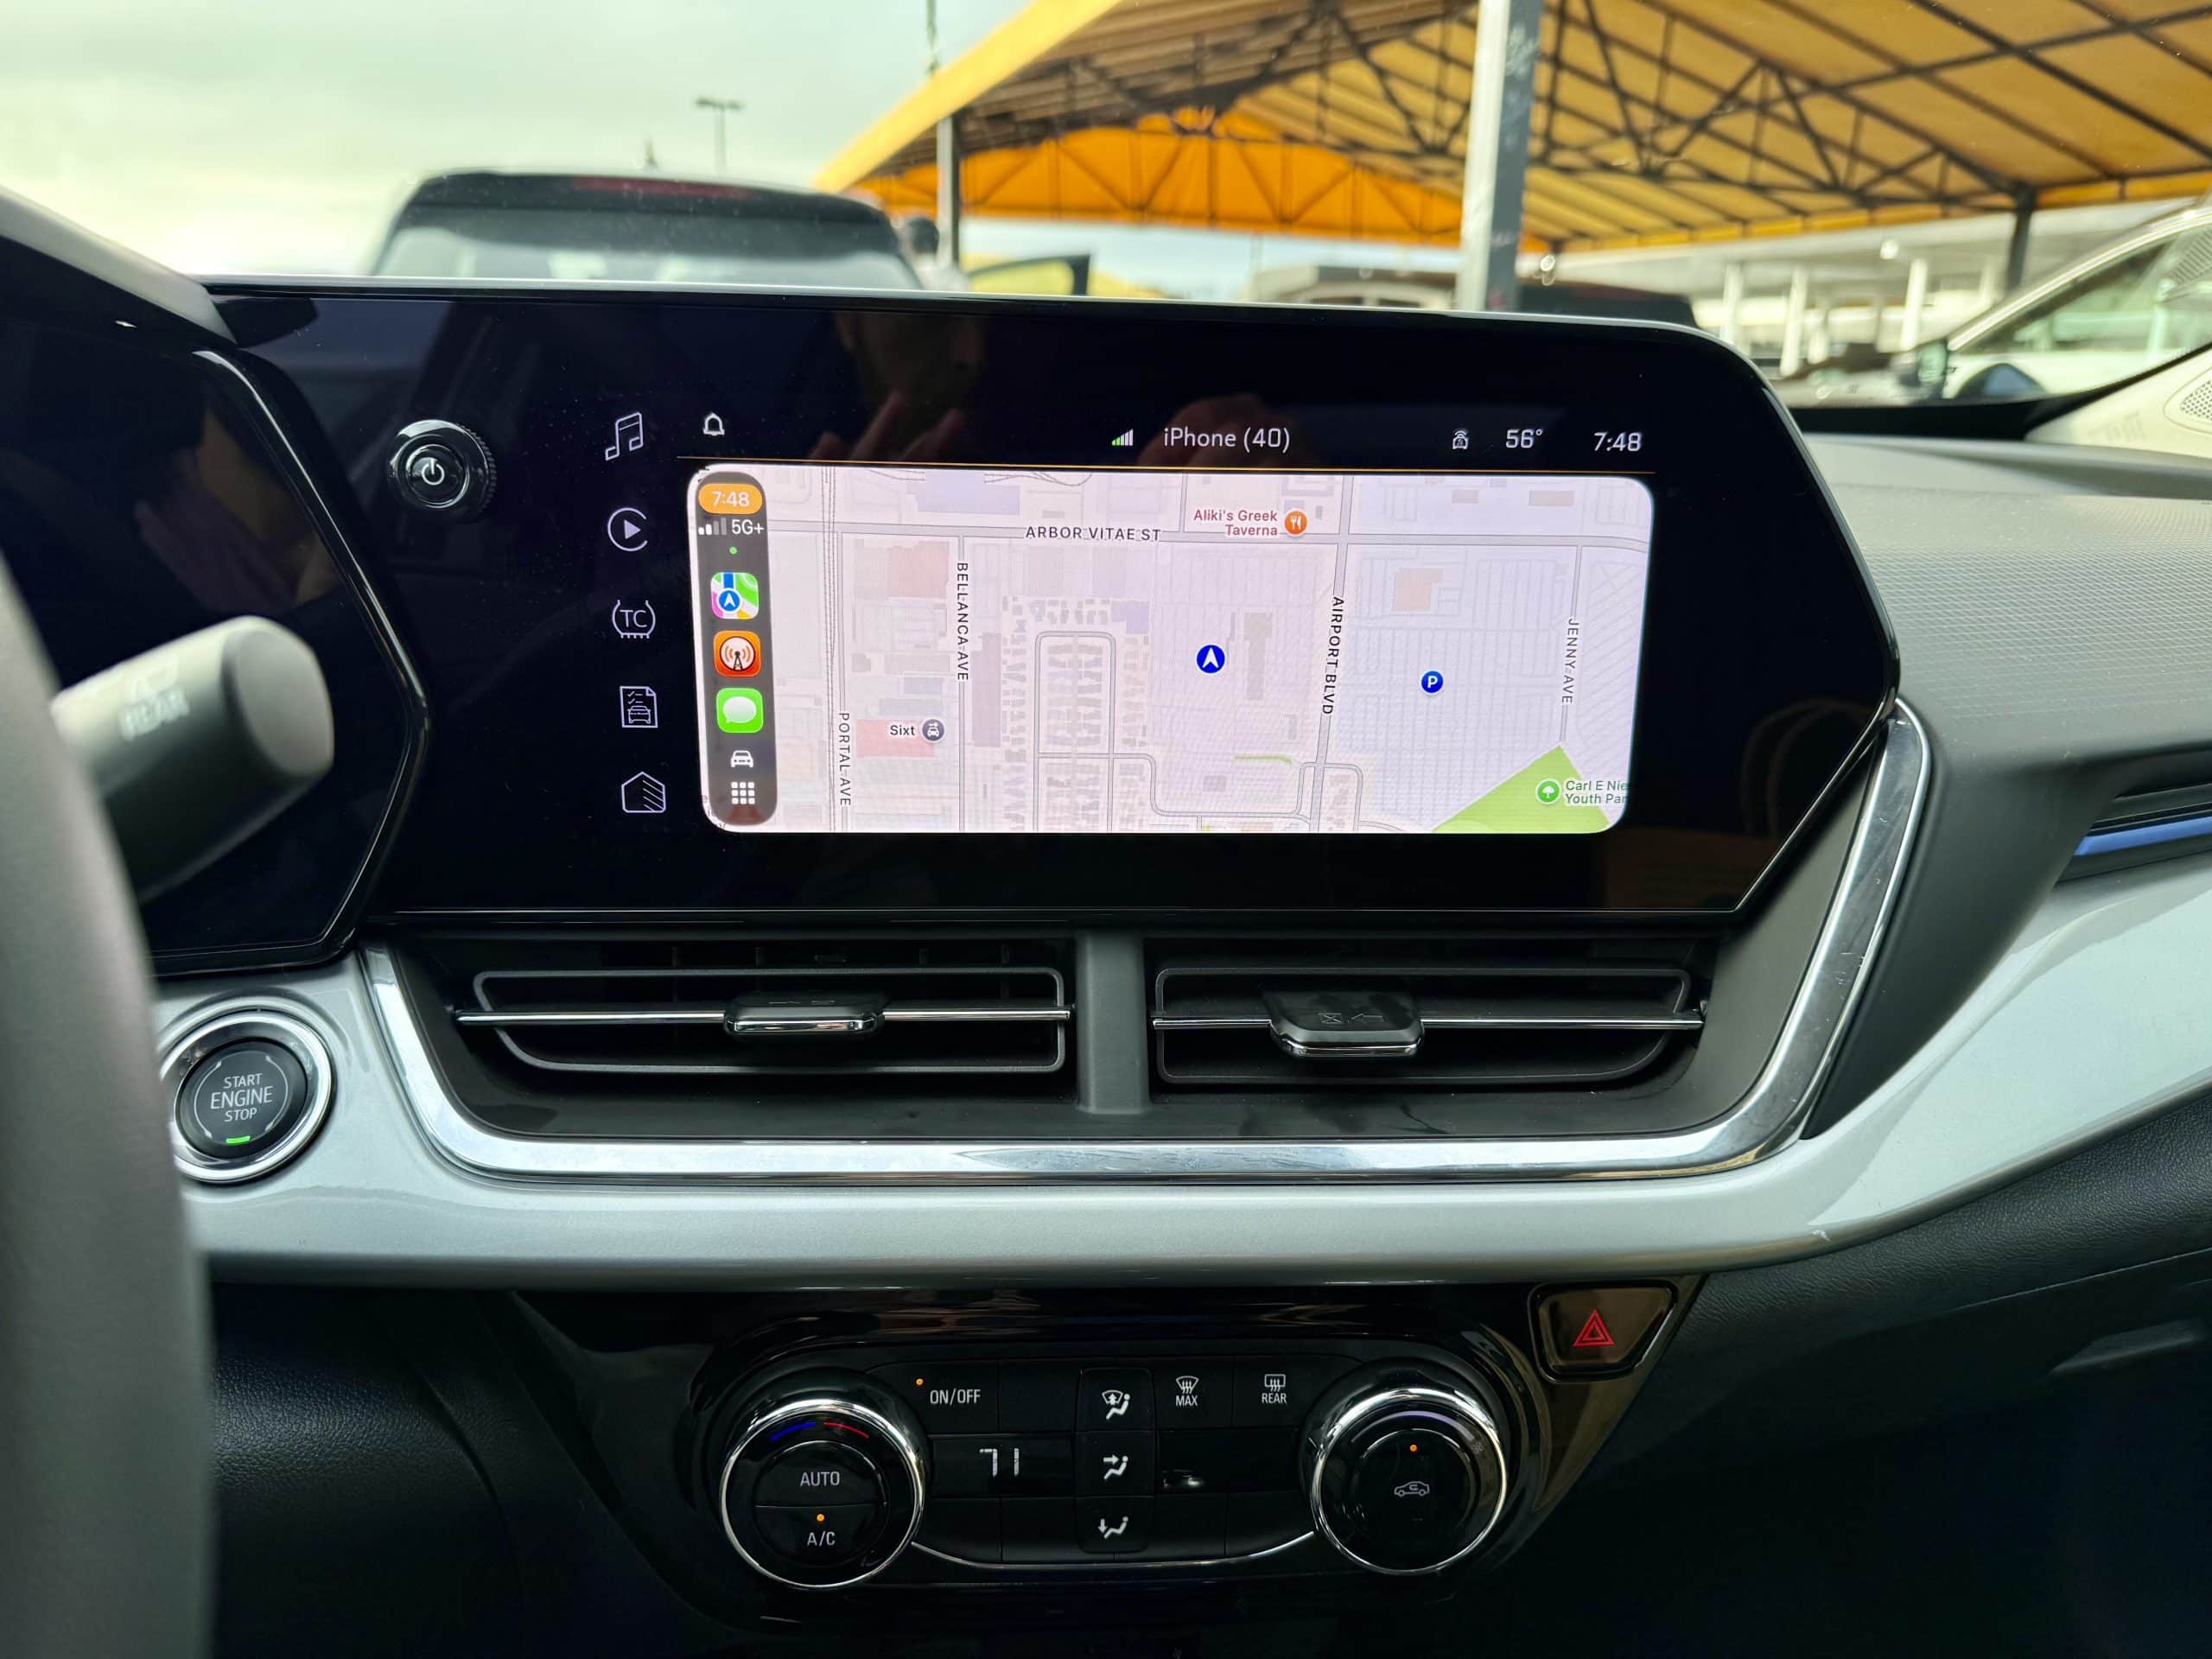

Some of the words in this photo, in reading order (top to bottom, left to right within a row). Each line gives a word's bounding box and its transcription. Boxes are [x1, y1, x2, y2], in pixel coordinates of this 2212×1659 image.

[1164, 427, 1236, 447] iPhone
[1243, 427, 1290, 454] (40)
[1505, 429, 1544, 448] 56°
[1593, 432, 1642, 452] 7:48
[711, 491, 750, 507] 7:48
[1193, 510, 1234, 521] Aliki's
[1237, 510, 1278, 521] Greek
[731, 519, 765, 535] 5G+
[1026, 526, 1082, 539] ARBOR
[1089, 527, 1135, 540] VITAE
[1141, 529, 1161, 541] ST
[1225, 524, 1278, 536] Taverna
[957, 563, 969, 645] BELLANCA
[620, 609, 648, 628] TC
[1326, 596, 1344, 668] AIRPORT
[1565, 618, 1580, 669] JENNY
[957, 651, 969, 681] AVE
[1427, 676, 1439, 689] P
[1561, 675, 1574, 703] AVE
[1322, 674, 1337, 715] BLVD
[890, 724, 915, 736] Sixt
[838, 713, 851, 772] PORTAL
[840, 777, 851, 805] AVE
[1566, 780, 1592, 791] Carl
[1595, 781, 1604, 791] E
[1565, 793, 1602, 804] Youth
[223, 1072, 263, 1089] START
[210, 1085, 274, 1110] ENGINE
[224, 1108, 257, 1122] STOP
[929, 1389, 982, 1406] ON/OFF
[1175, 1395, 1198, 1407] MAX
[1261, 1392, 1287, 1404] REAR
[979, 1447, 1020, 1478] 71
[800, 1471, 841, 1487] AUTO
[807, 1531, 836, 1547] A/C
